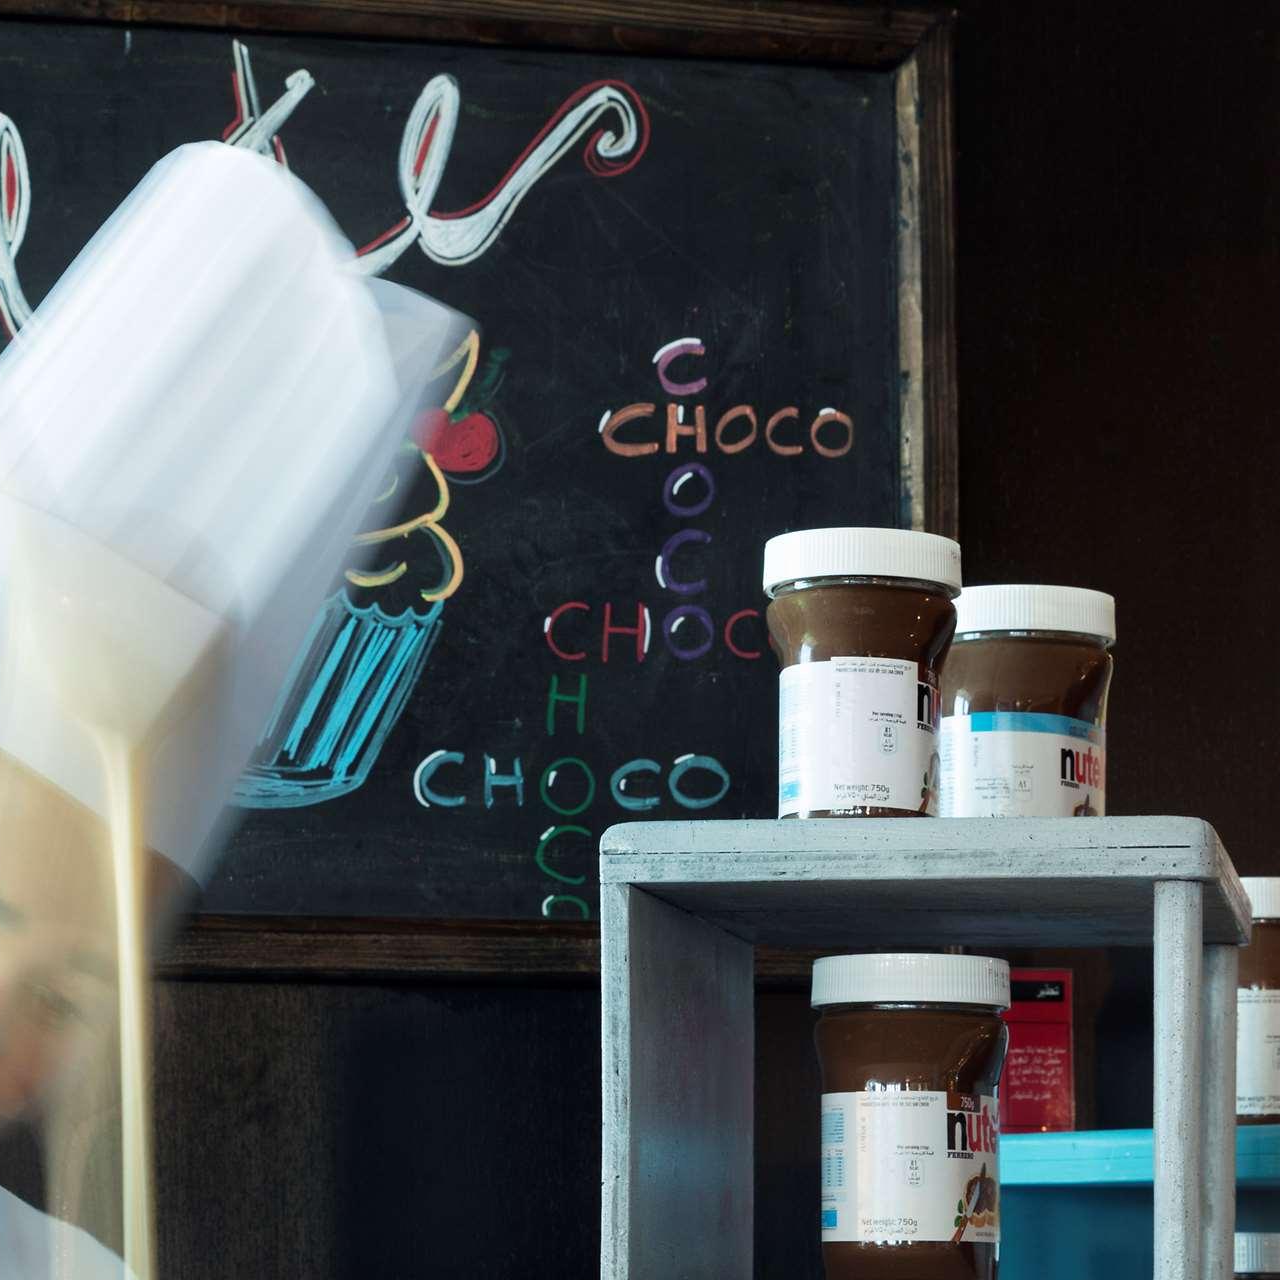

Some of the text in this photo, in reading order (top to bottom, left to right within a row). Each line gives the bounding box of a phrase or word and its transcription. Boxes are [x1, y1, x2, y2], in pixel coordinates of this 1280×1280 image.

[599, 402, 854, 457] CHOCO
[544, 601, 772, 663] CHOC
[413, 749, 731, 816] CHOCO
[1061, 747, 1104, 790] nute
